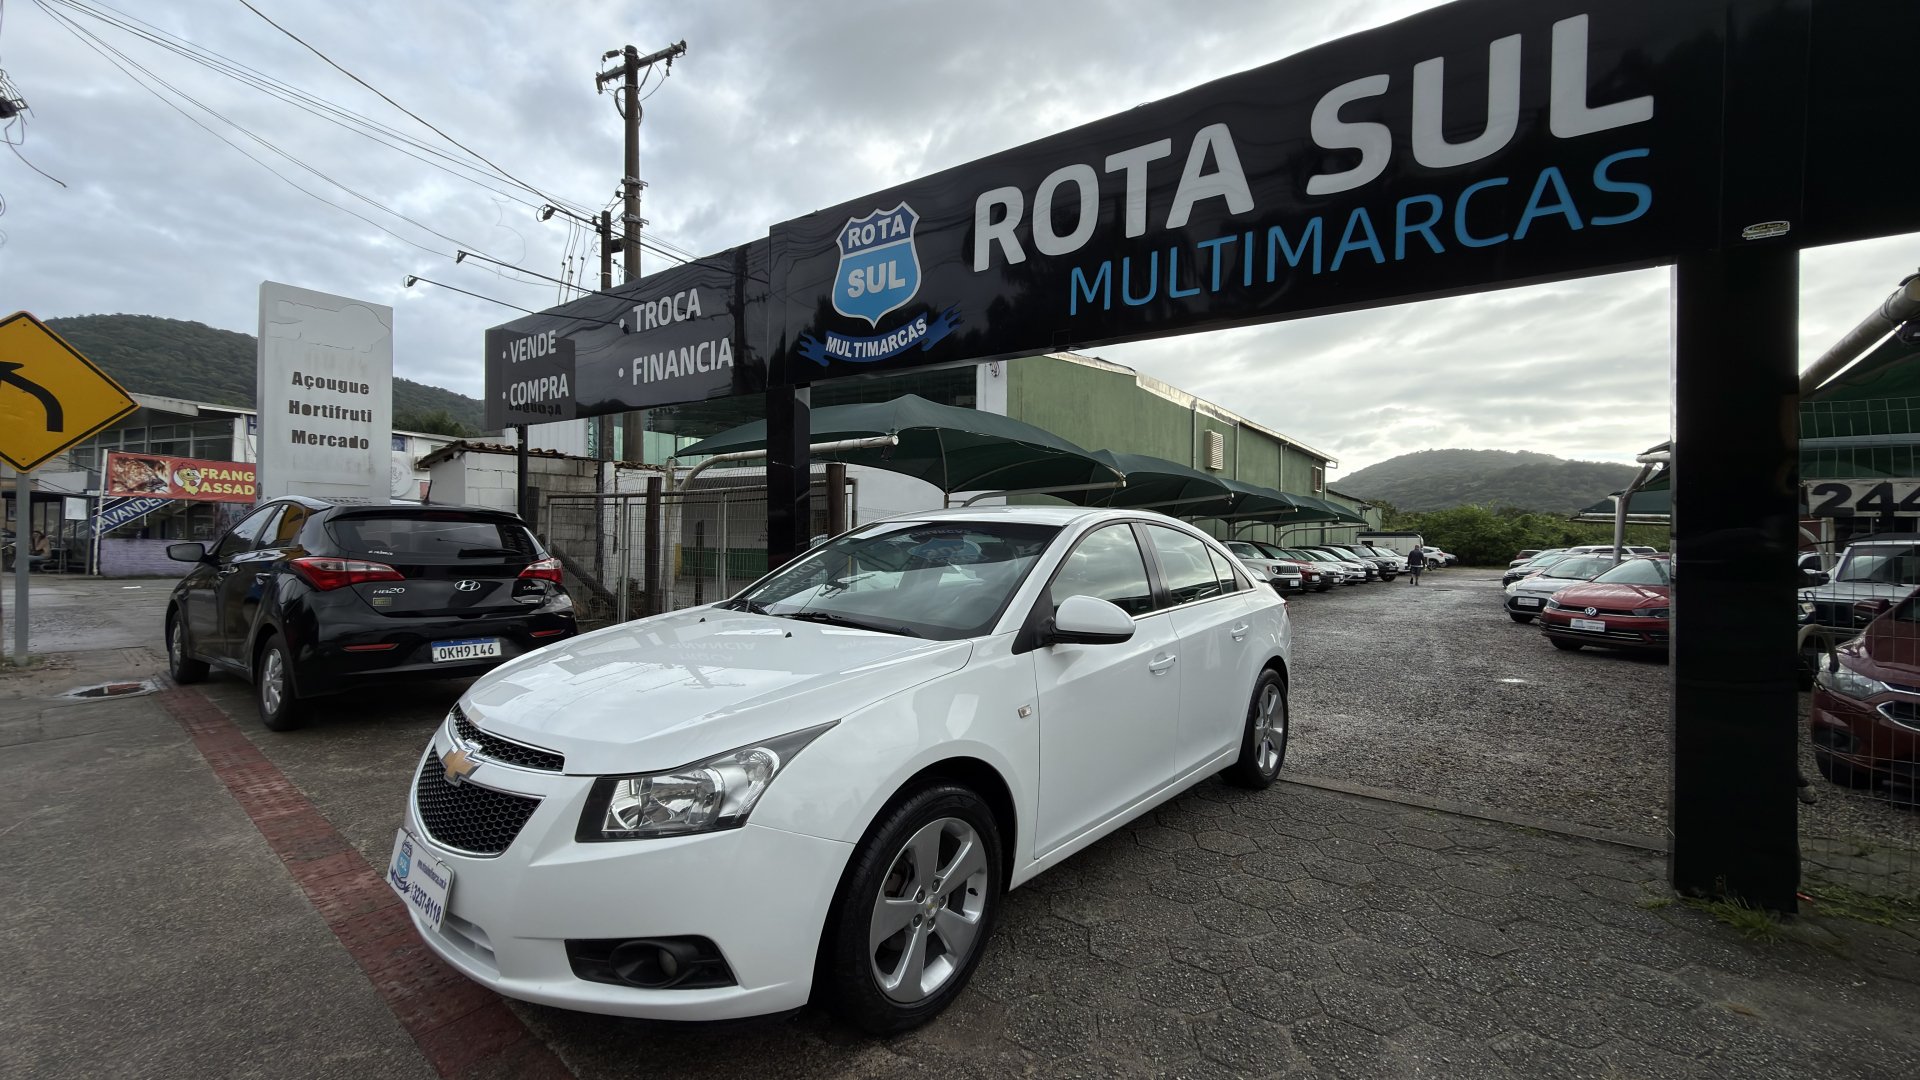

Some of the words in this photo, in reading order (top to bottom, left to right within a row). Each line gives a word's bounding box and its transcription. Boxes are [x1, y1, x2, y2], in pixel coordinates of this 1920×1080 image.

[974, 123, 1254, 273] ROTA
[1306, 13, 1654, 196] SUL
[848, 214, 906, 249] ROTA
[1070, 148, 1653, 316] MULTIMARCAS
[847, 260, 906, 298] SUL
[633, 288, 701, 332] TROCA
[510, 329, 556, 363] VENDE
[825, 318, 927, 358] MULTIMARCAS
[632, 337, 734, 386] FINANCIA
[291, 371, 370, 395] Açougue
[510, 373, 569, 406] COMPRA
[288, 399, 372, 423] Hortifruti
[291, 429, 369, 450] Mercado
[200, 483, 255, 496] ASSAD
[201, 468, 255, 482] FRANG
[440, 643, 494, 659] OKH9I46
